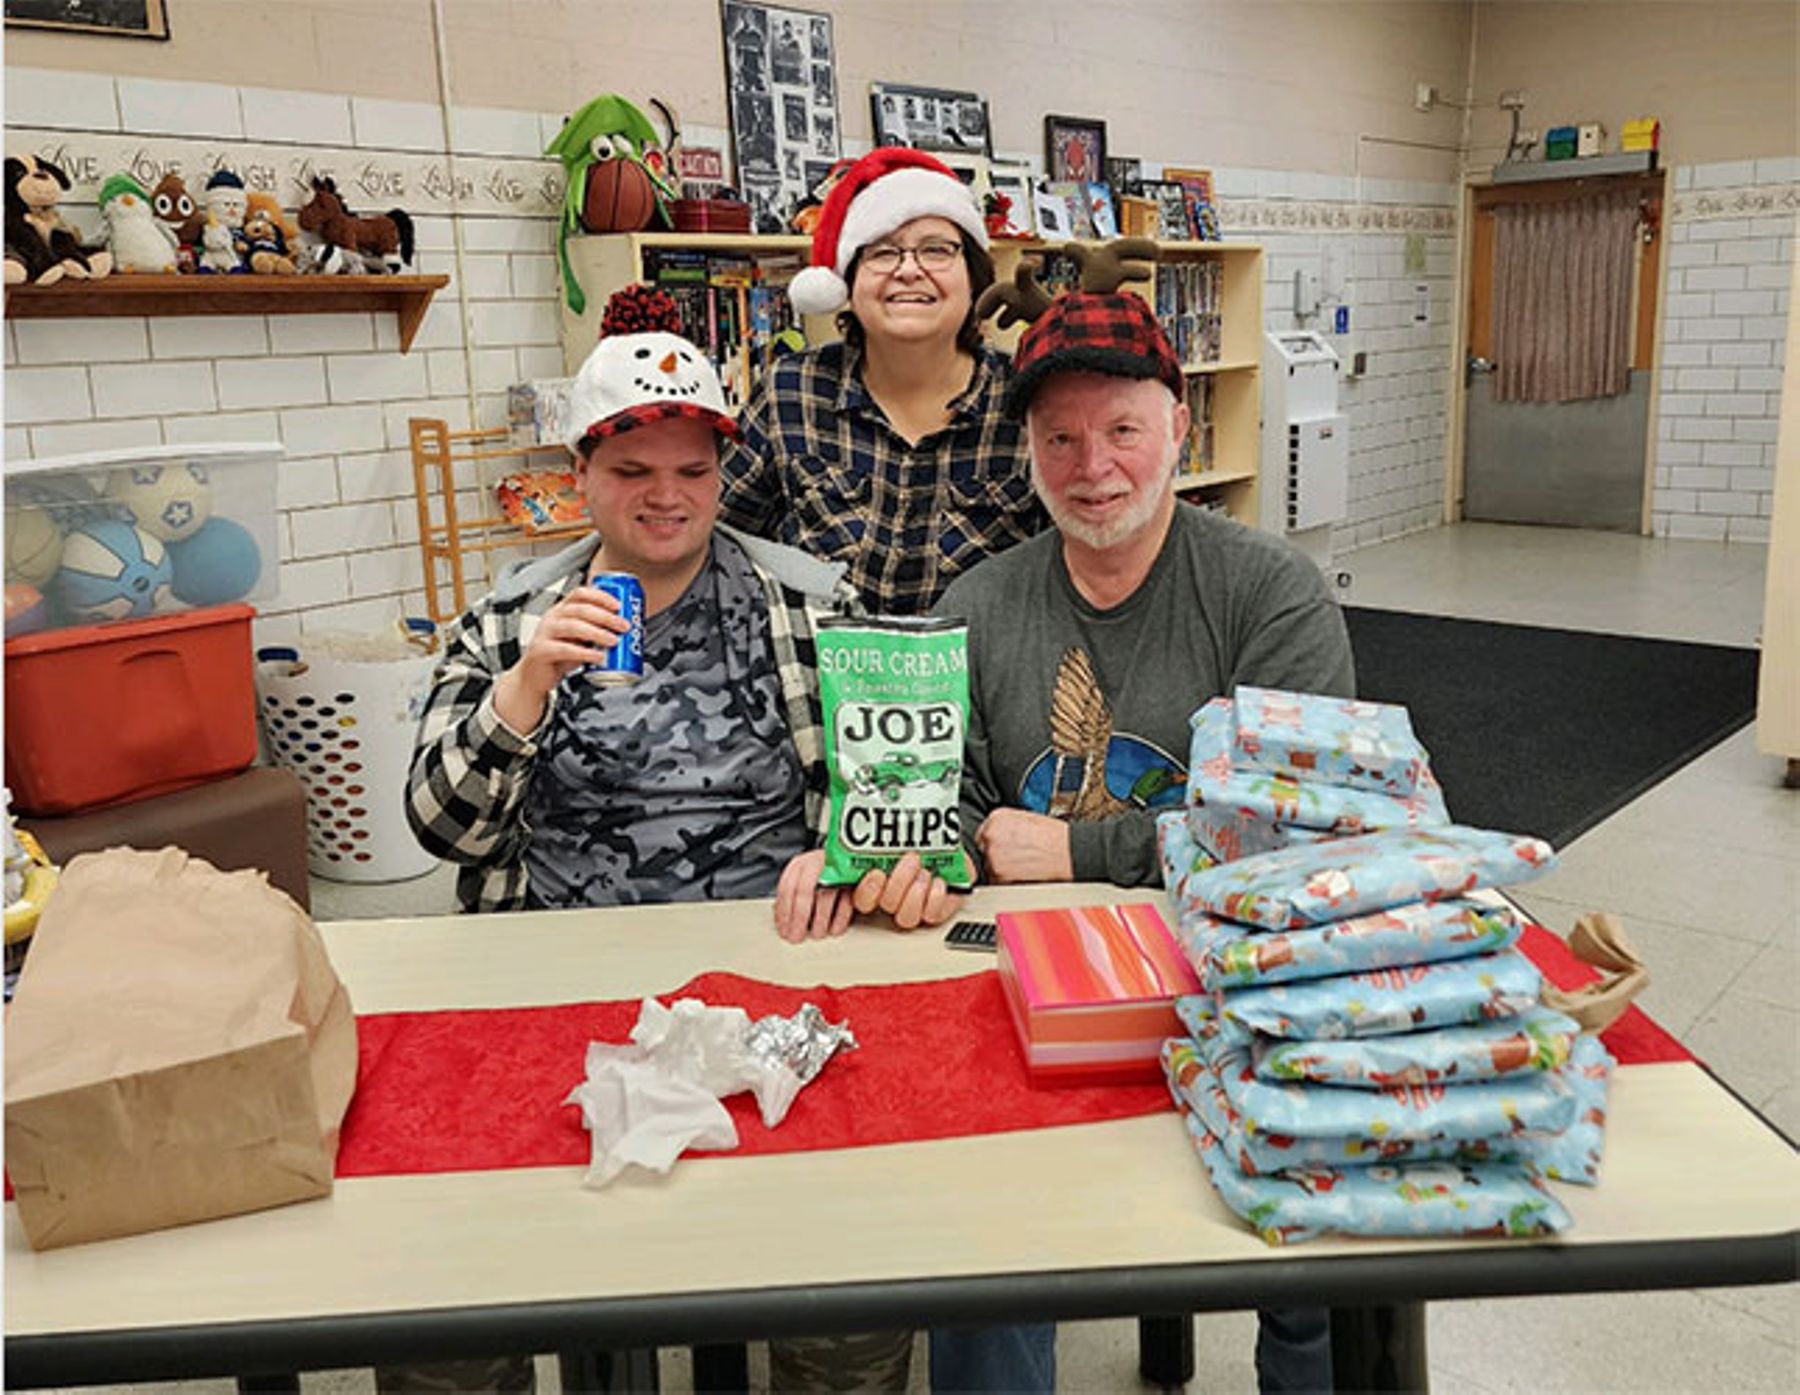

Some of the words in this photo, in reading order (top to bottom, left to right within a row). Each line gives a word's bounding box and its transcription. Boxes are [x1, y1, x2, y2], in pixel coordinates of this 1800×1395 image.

[820, 647, 884, 673] SOUR
[889, 646, 967, 677] CREAM
[844, 706, 954, 744] JOE
[844, 805, 960, 847] CHIPS
